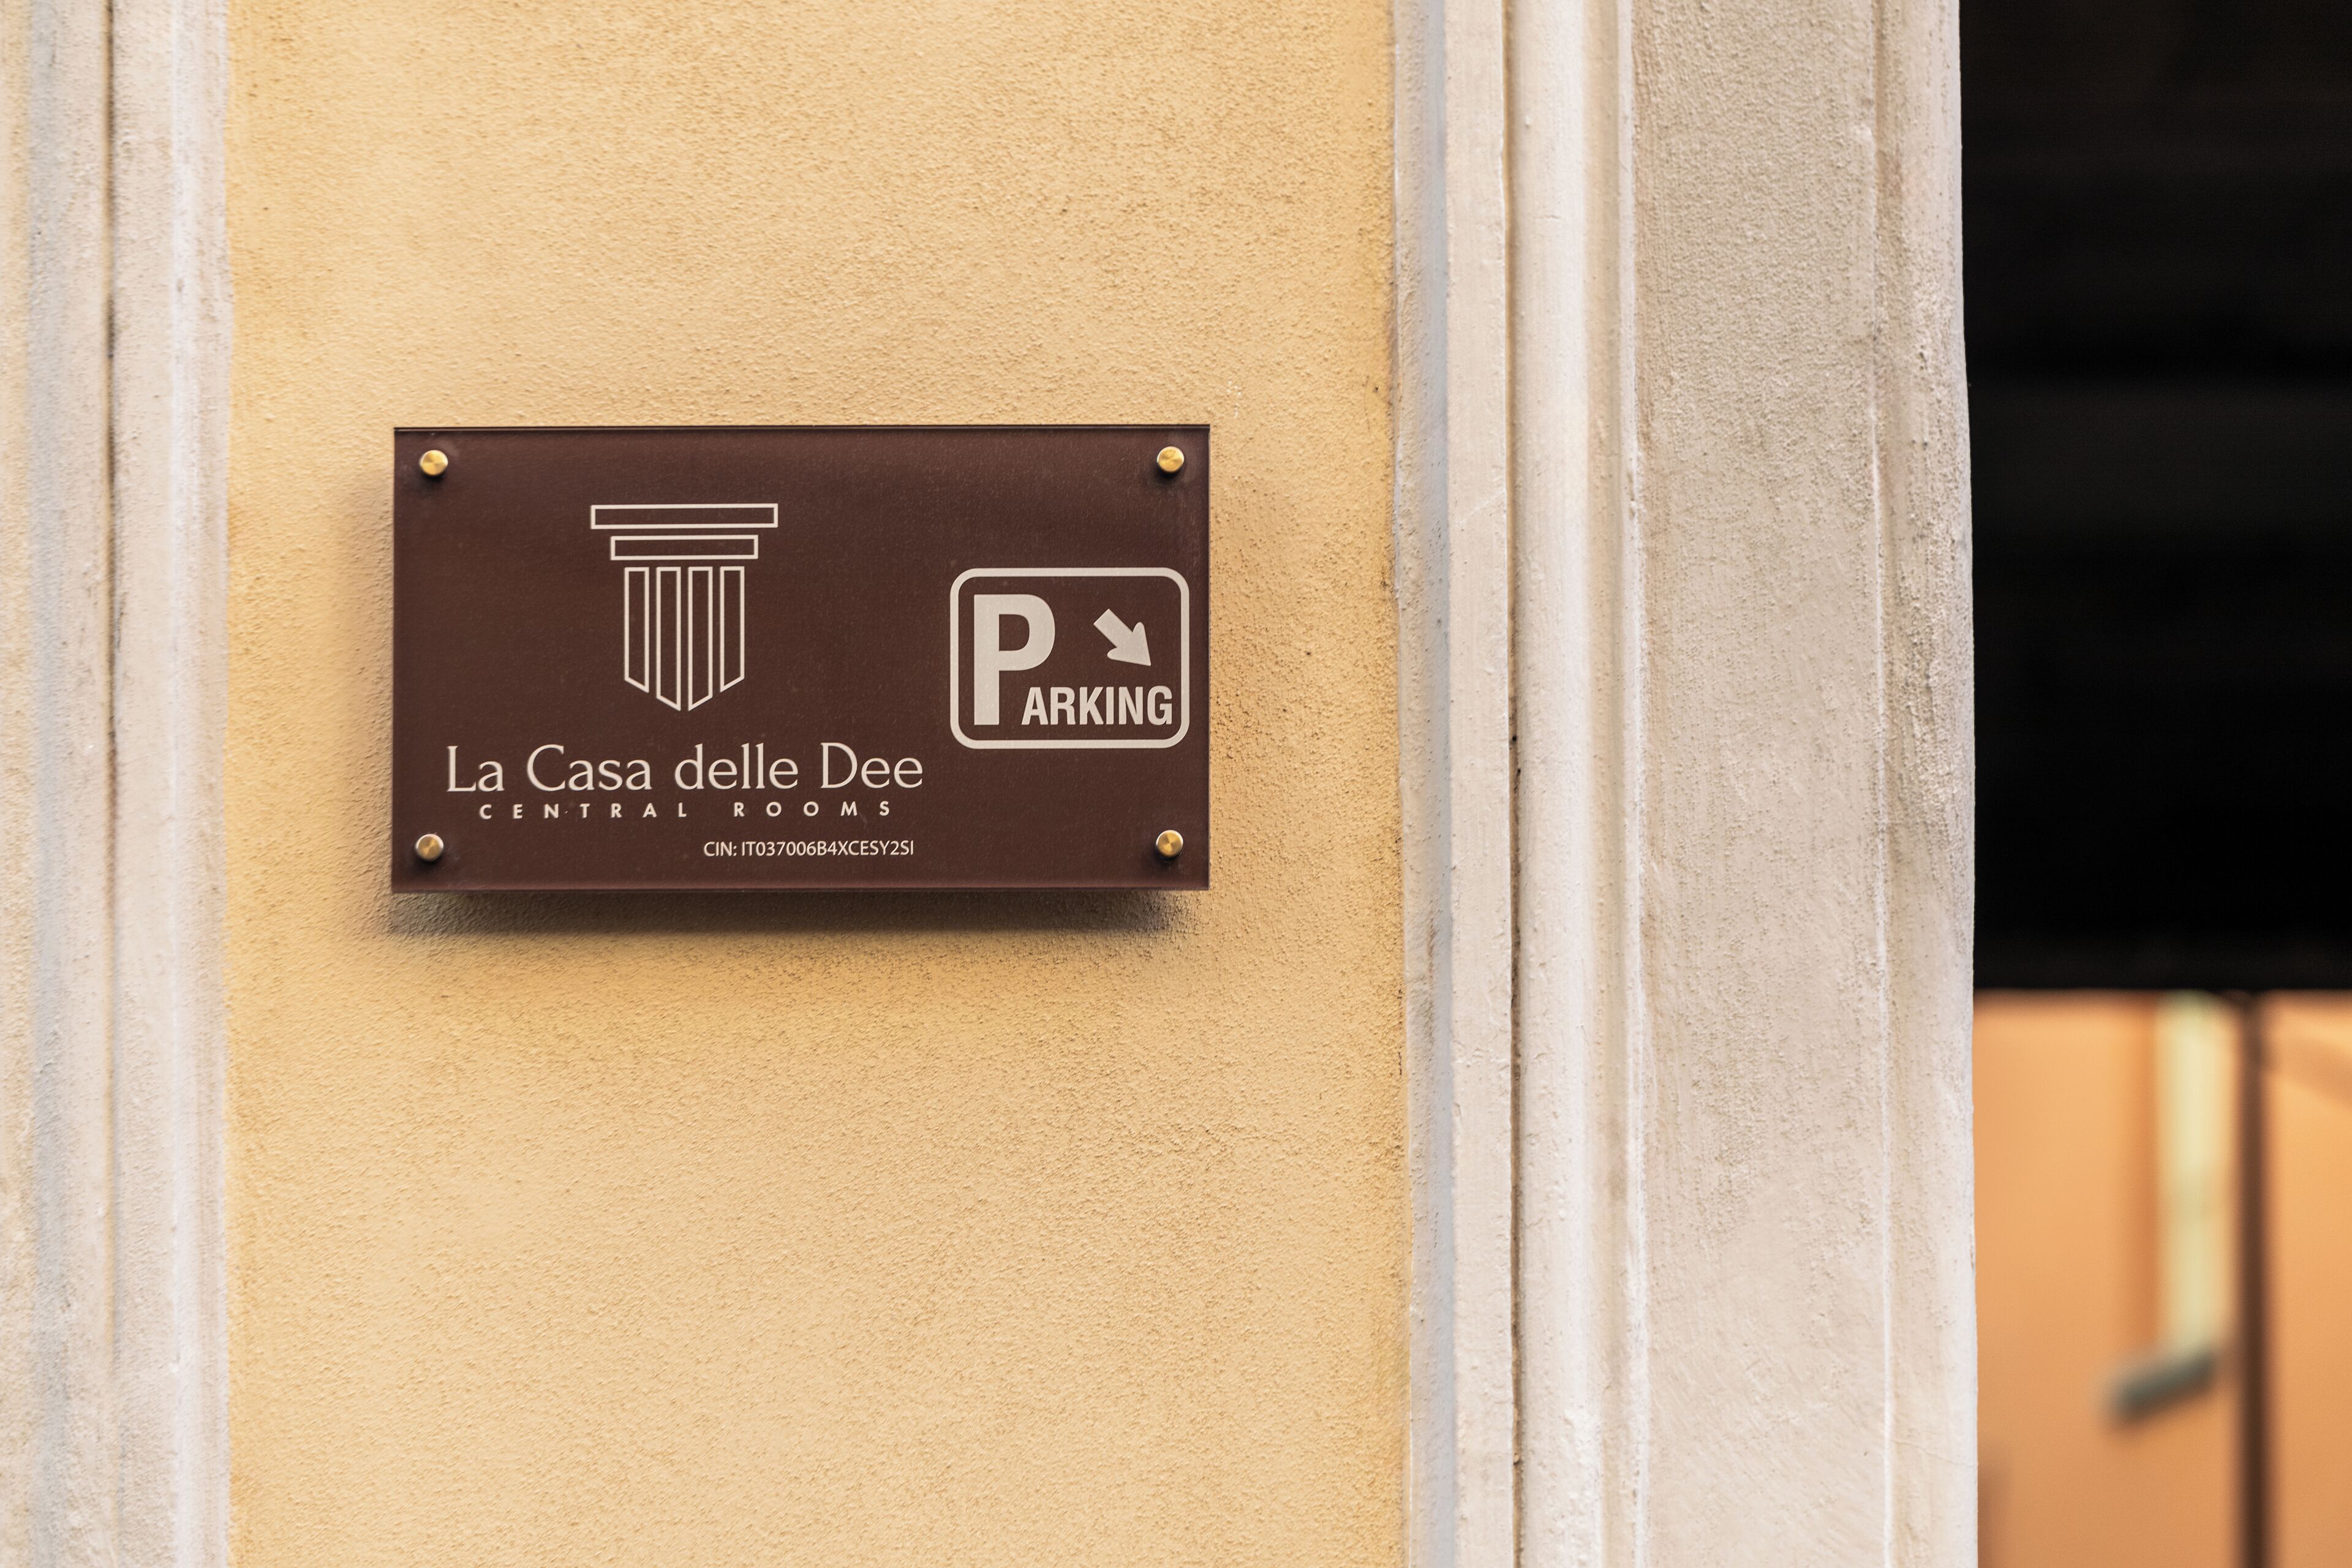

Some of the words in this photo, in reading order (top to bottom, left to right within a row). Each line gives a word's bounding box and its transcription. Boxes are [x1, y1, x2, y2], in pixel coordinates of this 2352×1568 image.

[974, 594, 1172, 725] PARKING
[447, 746, 504, 791] La
[527, 744, 652, 791] Casa
[675, 743, 798, 790] delle
[821, 742, 922, 788] Dee
[479, 802, 687, 819] CENTRAL
[734, 801, 889, 816] ROOMS
[704, 842, 737, 856] CIN:
[742, 840, 913, 856] IT037006B4XCESY2SI
